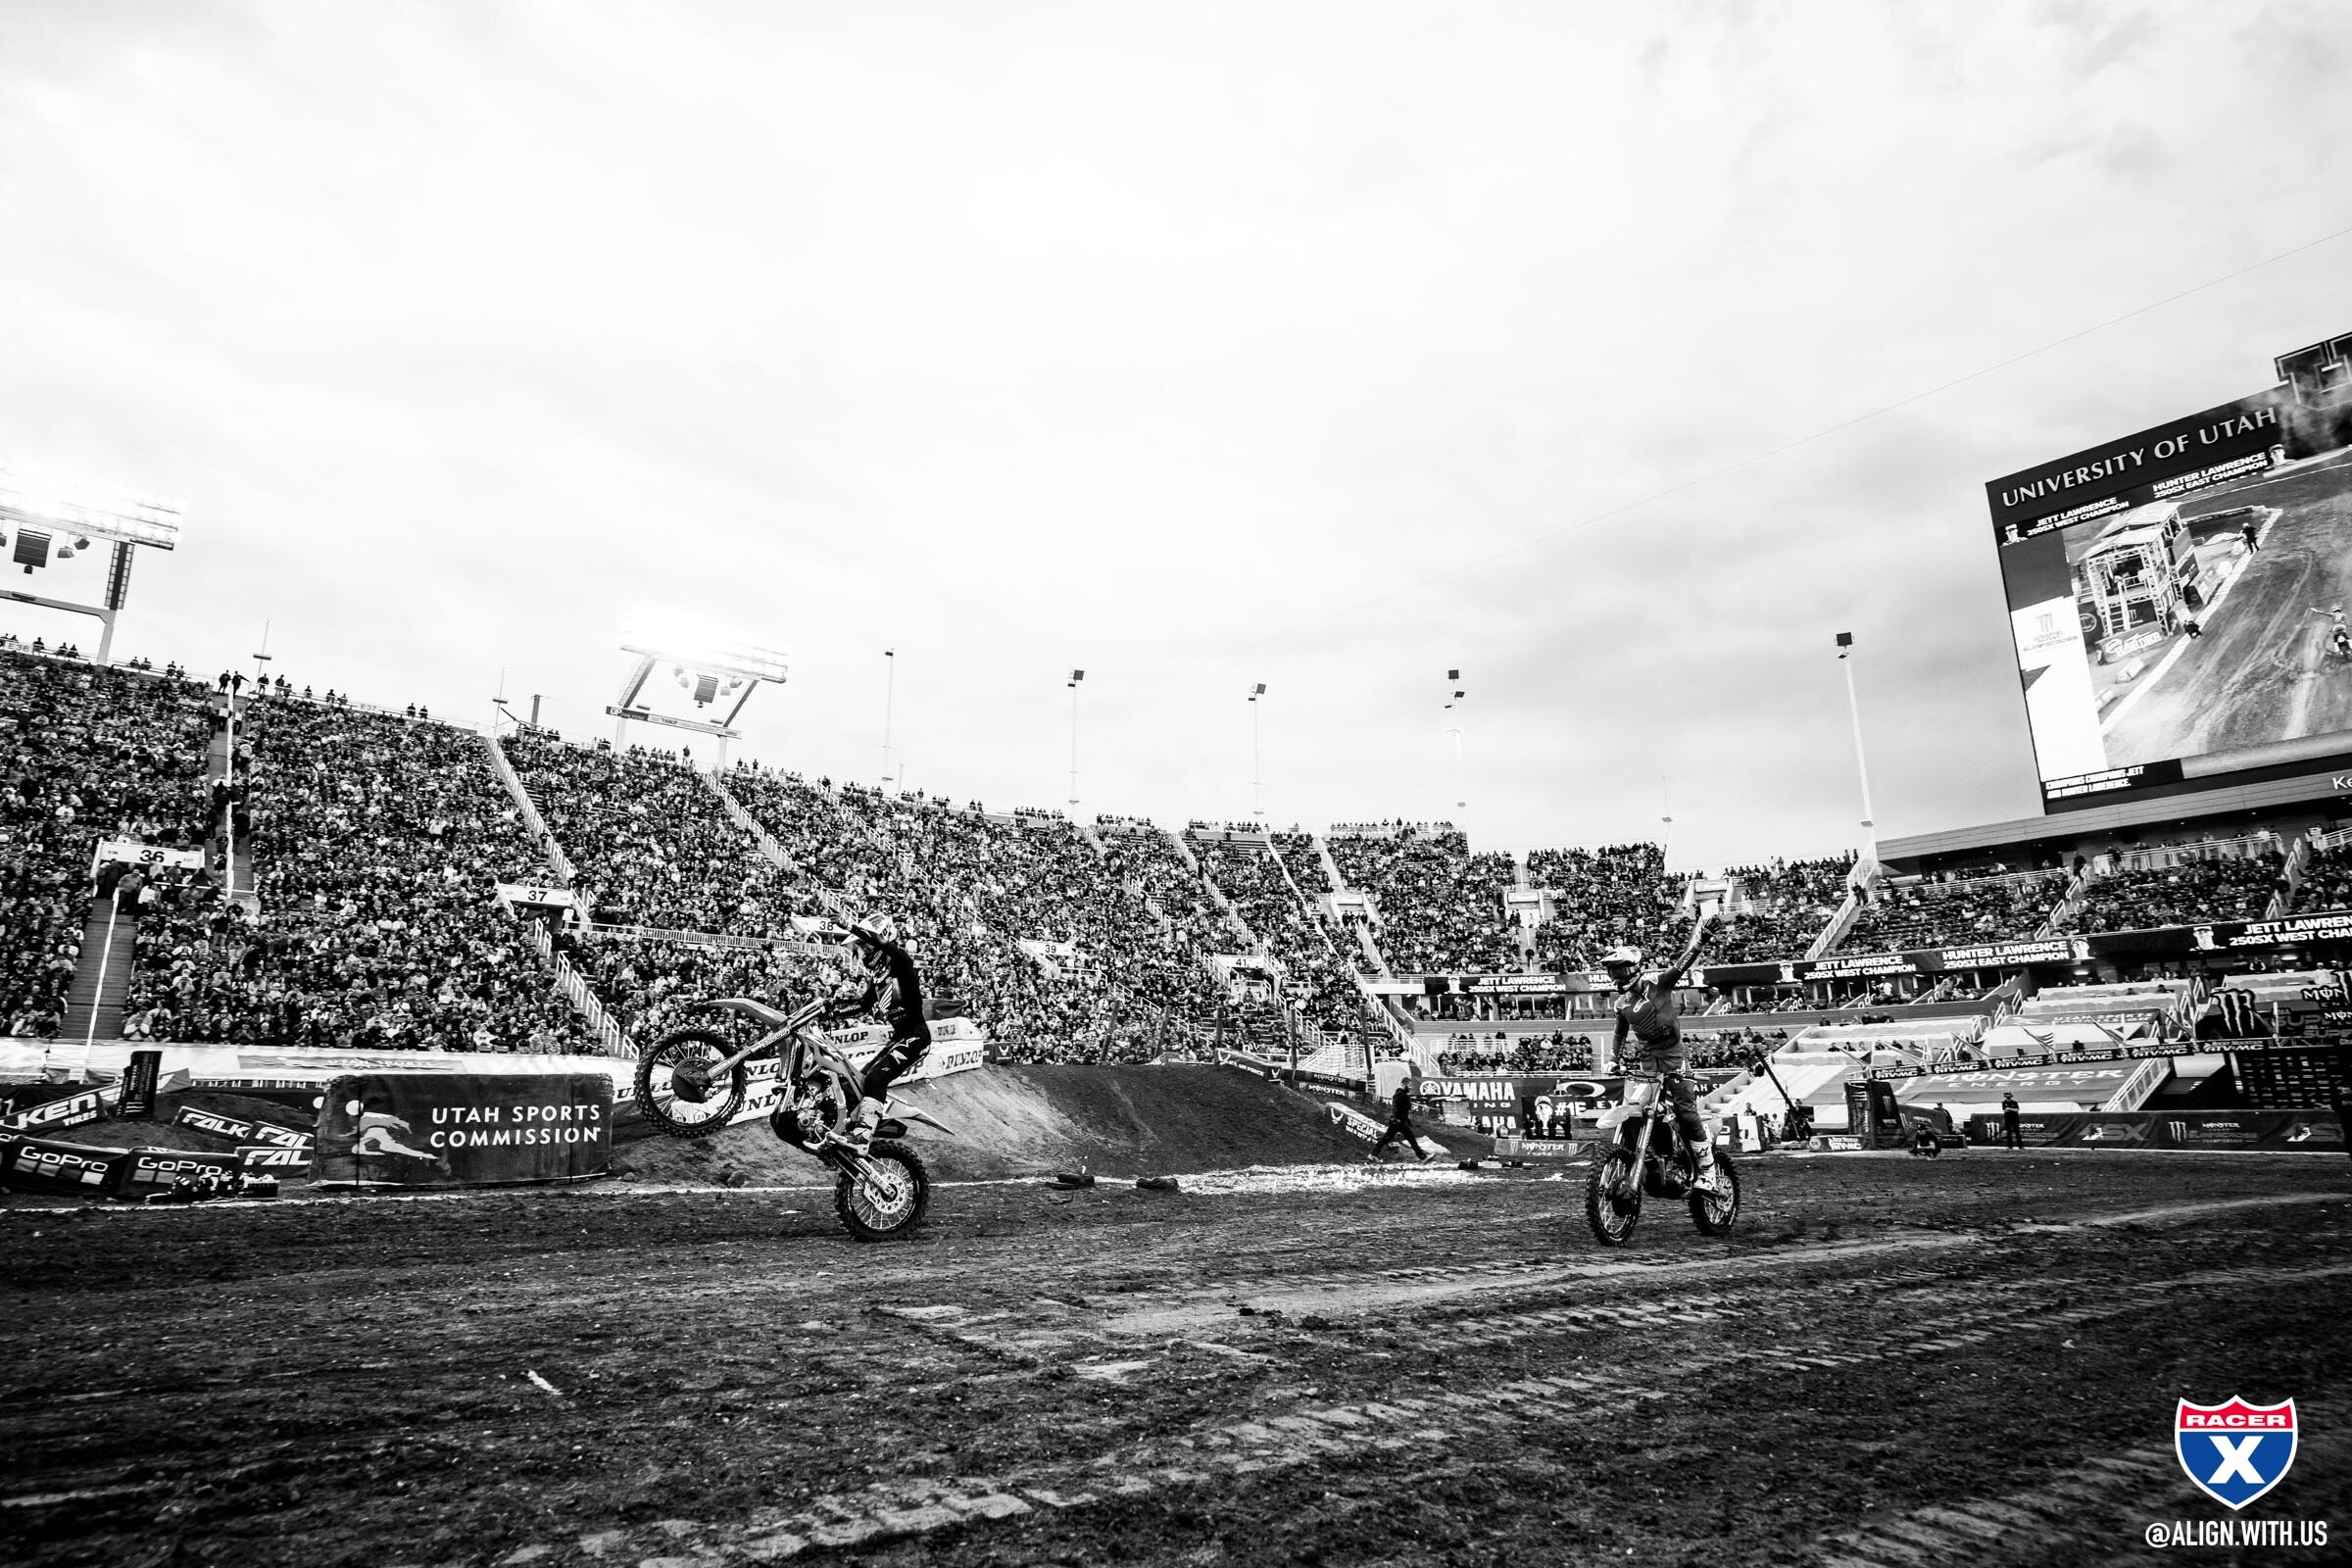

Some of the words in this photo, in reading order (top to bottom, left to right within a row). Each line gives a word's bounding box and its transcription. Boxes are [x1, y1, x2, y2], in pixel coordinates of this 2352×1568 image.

[2001, 448, 2146, 507] UNIVERSITY
[2154, 434, 2190, 459] OF
[2199, 407, 2278, 445] UTAH
[2152, 471, 2200, 492] HUNTER
[2200, 452, 2266, 477] LAWRENCE
[2185, 476, 2212, 489] EAST
[2212, 460, 2269, 480] CHAMPION
[2036, 514, 2060, 527] JETT
[2060, 497, 2118, 519] LAWRENCE
[2054, 515, 2080, 528] WEST
[2080, 501, 2130, 520] CHAMPION
[139, 850, 165, 862] 36
[528, 890, 548, 902] 37
[819, 921, 834, 931] 38
[2243, 922, 2281, 935] JETT
[2229, 934, 2275, 946] 250SX
[2275, 930, 2316, 943] WEST
[1045, 944, 1056, 954] 39
[1942, 948, 1993, 960] HUNTER
[1995, 941, 2068, 956] LAWRENCE
[1236, 957, 1247, 967] 41
[1677, 951, 1694, 972] HONDA
[1814, 961, 1839, 971] JETT
[1840, 956, 1903, 968] LAWRENCE
[1943, 958, 1978, 969] 250SX
[1979, 956, 2006, 966] EAST
[2007, 952, 2069, 963] CHAMPION
[1804, 970, 1835, 980] 250SX
[1835, 968, 1861, 977] WEST
[1862, 963, 1916, 975] CHAMPION
[834, 1030, 869, 1045] NLOP
[1928, 1069, 2125, 1082] MONSTER
[1308, 1084, 1346, 1096] MONSTER
[1441, 1081, 1515, 1101] YAMAHA
[63, 1109, 97, 1127] TIRES
[432, 1106, 500, 1124] UTAH
[512, 1104, 600, 1122] SPORTS
[181, 1112, 252, 1138] FALK
[1346, 1116, 1379, 1140] SPECIAL
[255, 1126, 309, 1148] FAL
[430, 1127, 599, 1148] COMMISSION
[1521, 1142, 1565, 1152] MONSTER
[20, 1145, 109, 1172] GoPro
[137, 1156, 223, 1176] GoPro
[244, 1150, 313, 1166] FAL
